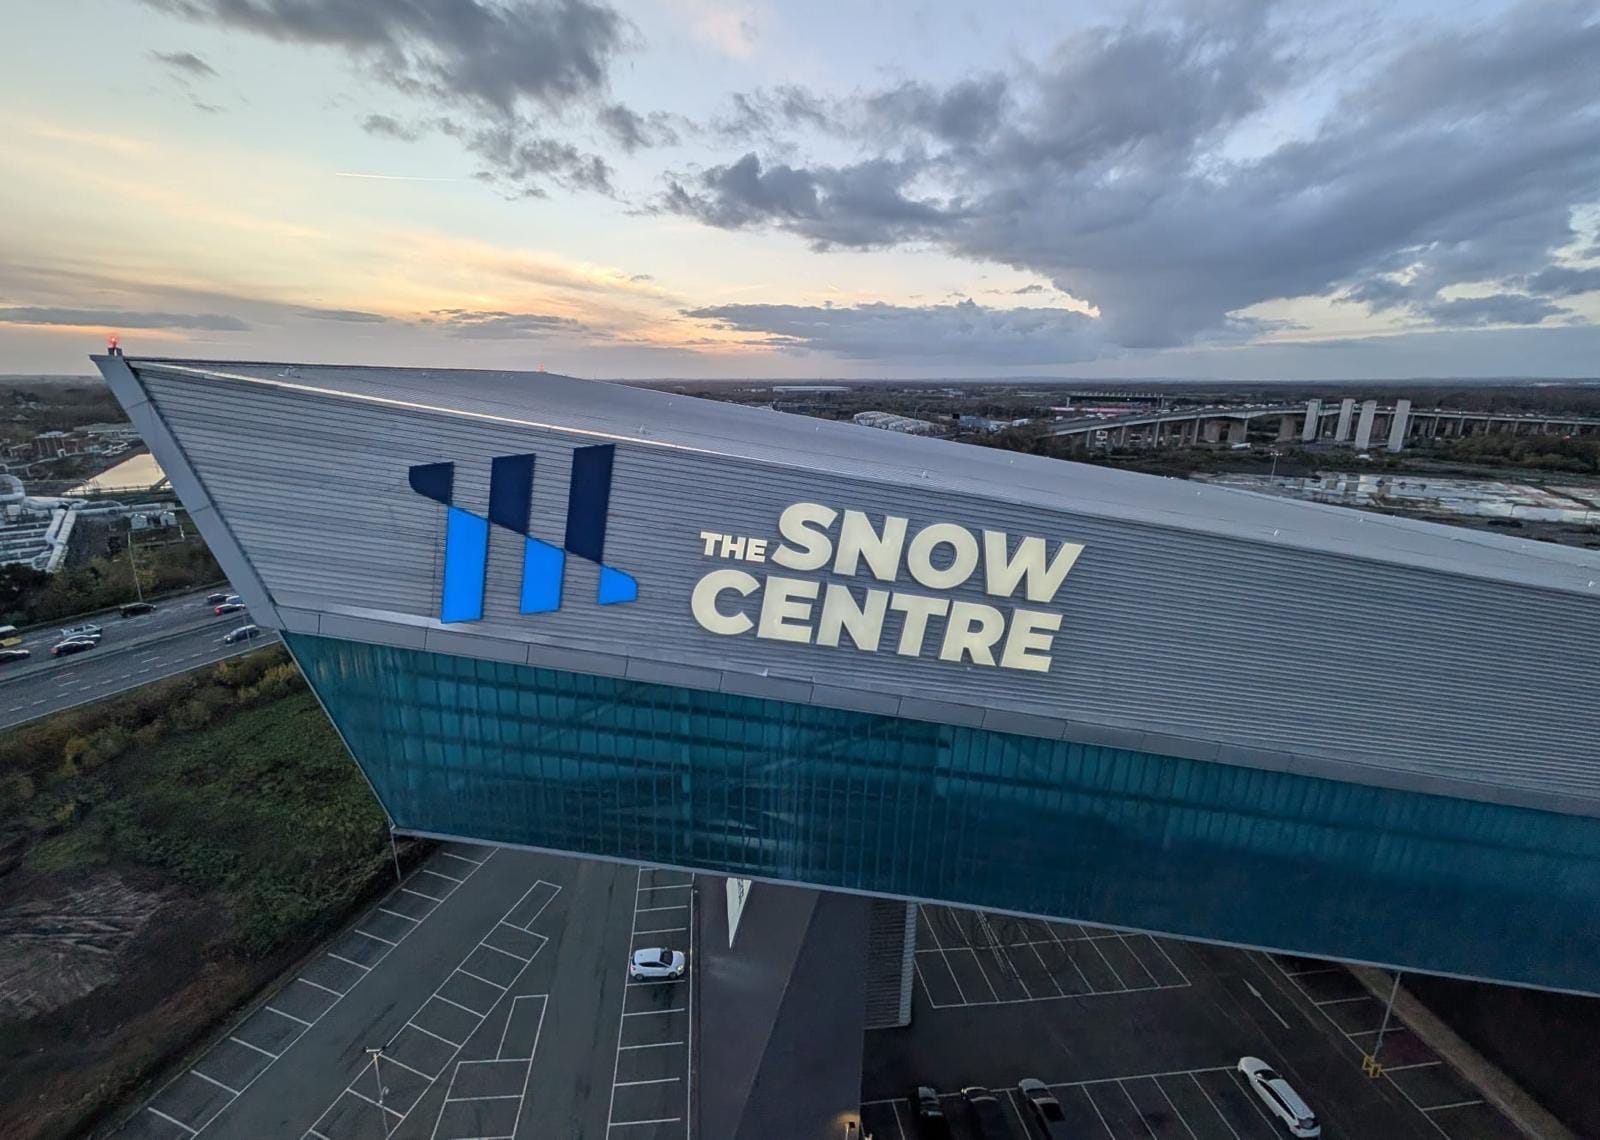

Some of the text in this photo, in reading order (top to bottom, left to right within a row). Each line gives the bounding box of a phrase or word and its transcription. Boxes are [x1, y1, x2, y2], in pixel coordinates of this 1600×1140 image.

[700, 502, 1085, 603] THE SNOW
[691, 569, 1063, 672] CENTRE
